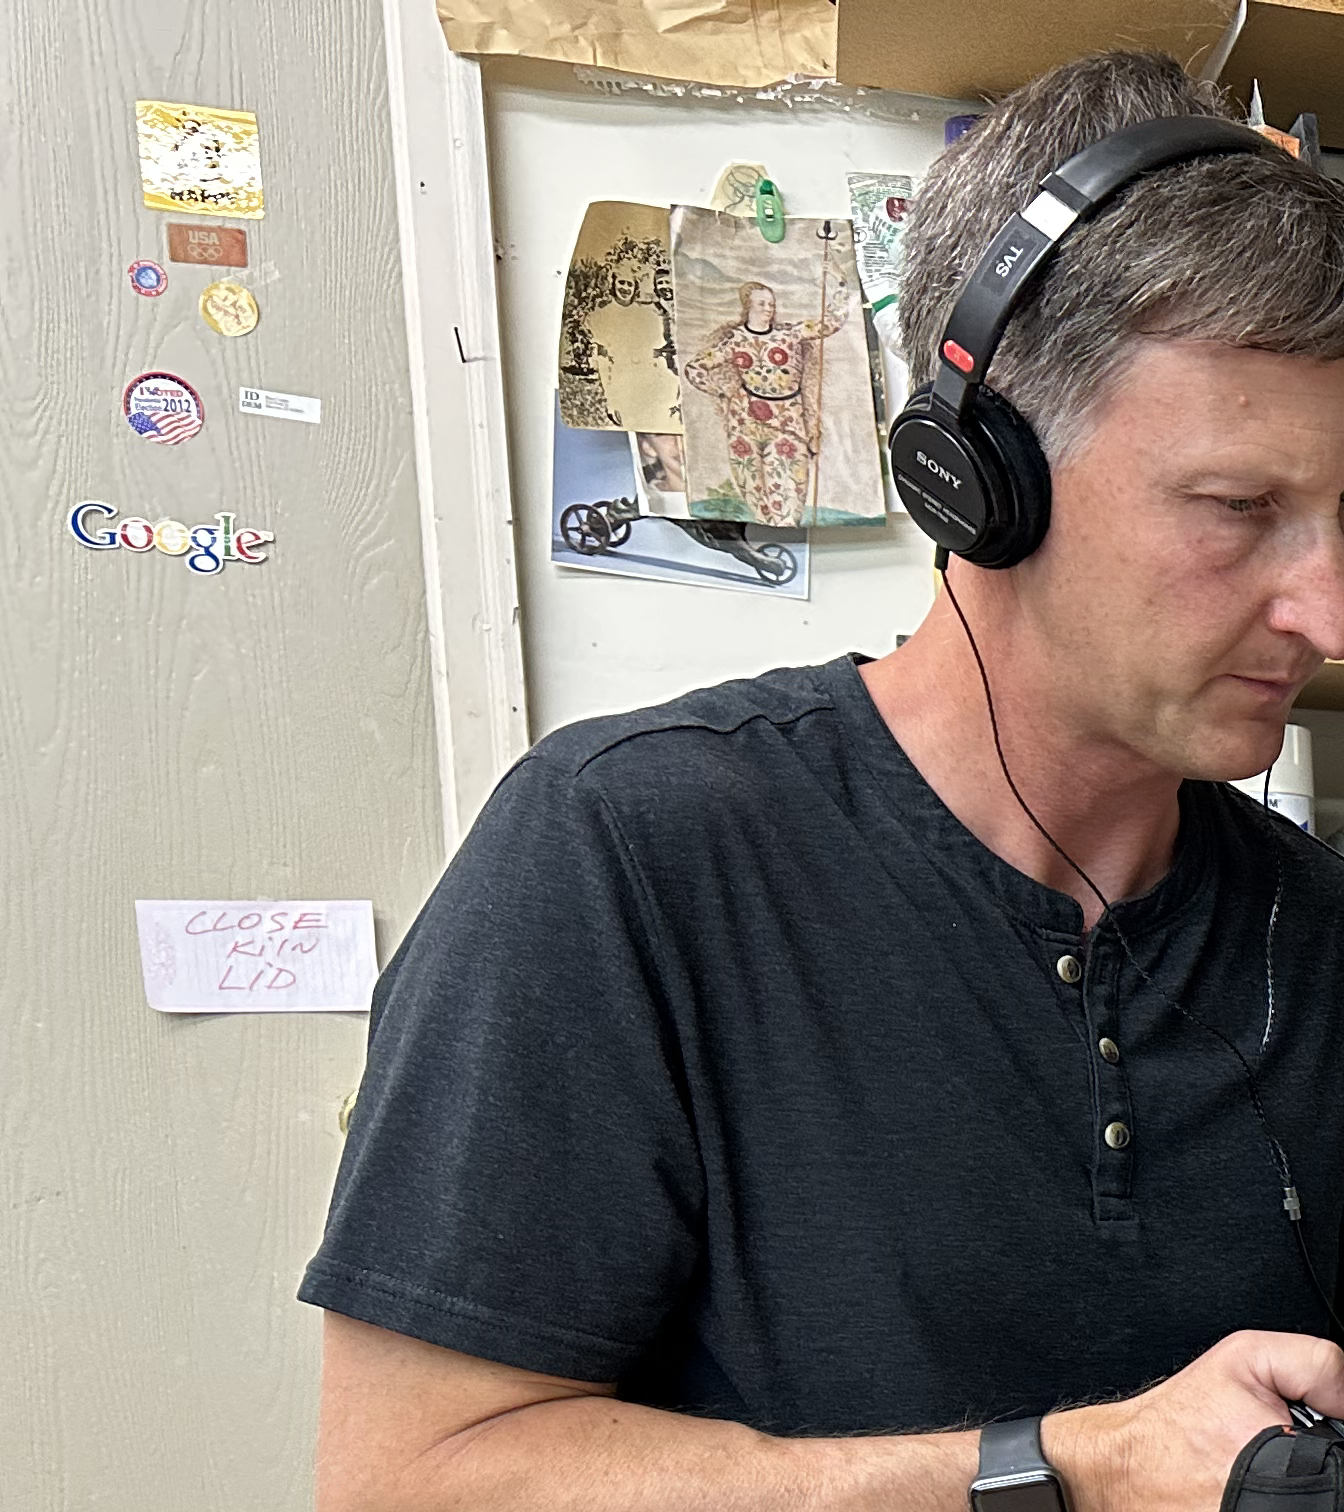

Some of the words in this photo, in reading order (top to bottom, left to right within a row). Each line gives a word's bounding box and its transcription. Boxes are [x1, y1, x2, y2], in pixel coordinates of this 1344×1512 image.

[188, 230, 219, 244] USA
[995, 245, 1024, 277] TVS
[162, 398, 192, 412] 2012
[916, 450, 963, 489] SONY
[71, 503, 263, 573] Google
[185, 911, 328, 935] CLOSE
